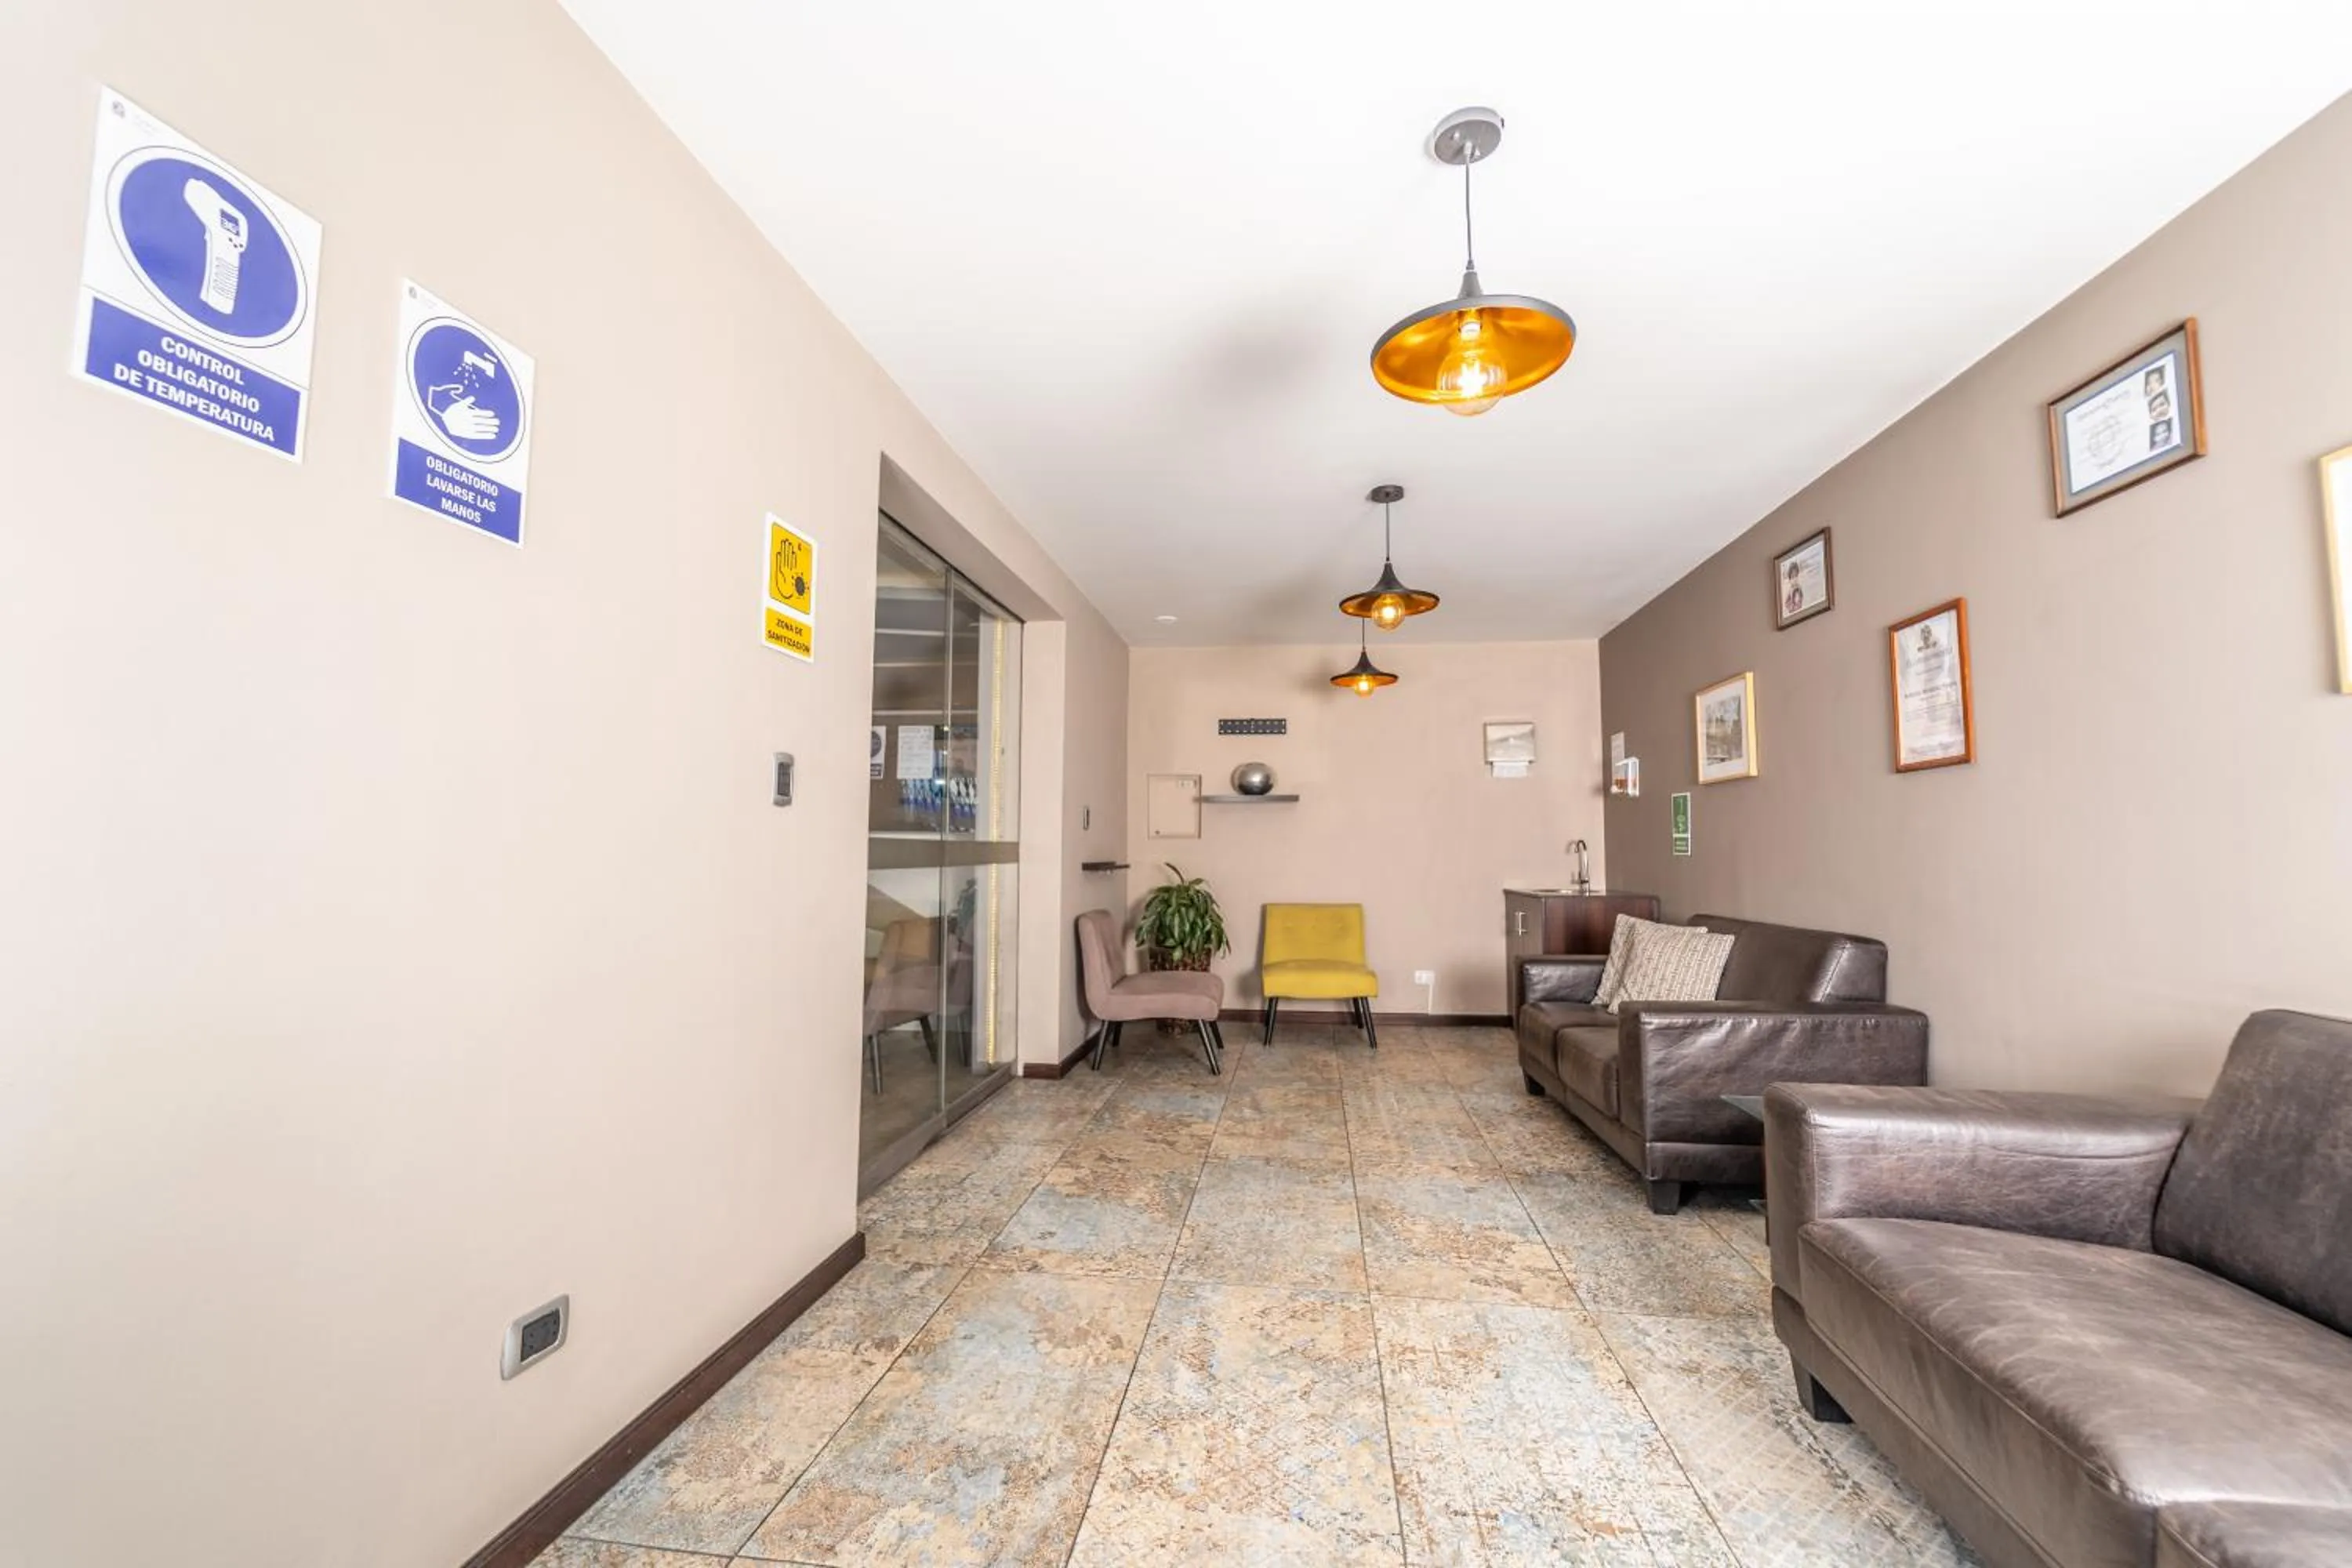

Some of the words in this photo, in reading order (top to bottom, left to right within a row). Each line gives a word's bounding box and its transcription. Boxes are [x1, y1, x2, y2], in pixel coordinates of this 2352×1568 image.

[162, 336, 245, 385] CONTROL
[138, 350, 260, 413] OBLIGATORIO
[114, 363, 142, 388] DE
[144, 376, 274, 441] TEMPERATURA
[426, 456, 498, 496] OBLIGATORIO
[426, 474, 475, 504] LAVARSE
[476, 494, 496, 512] LAS
[441, 497, 481, 523] MANOS
[777, 619, 793, 632] ZONA
